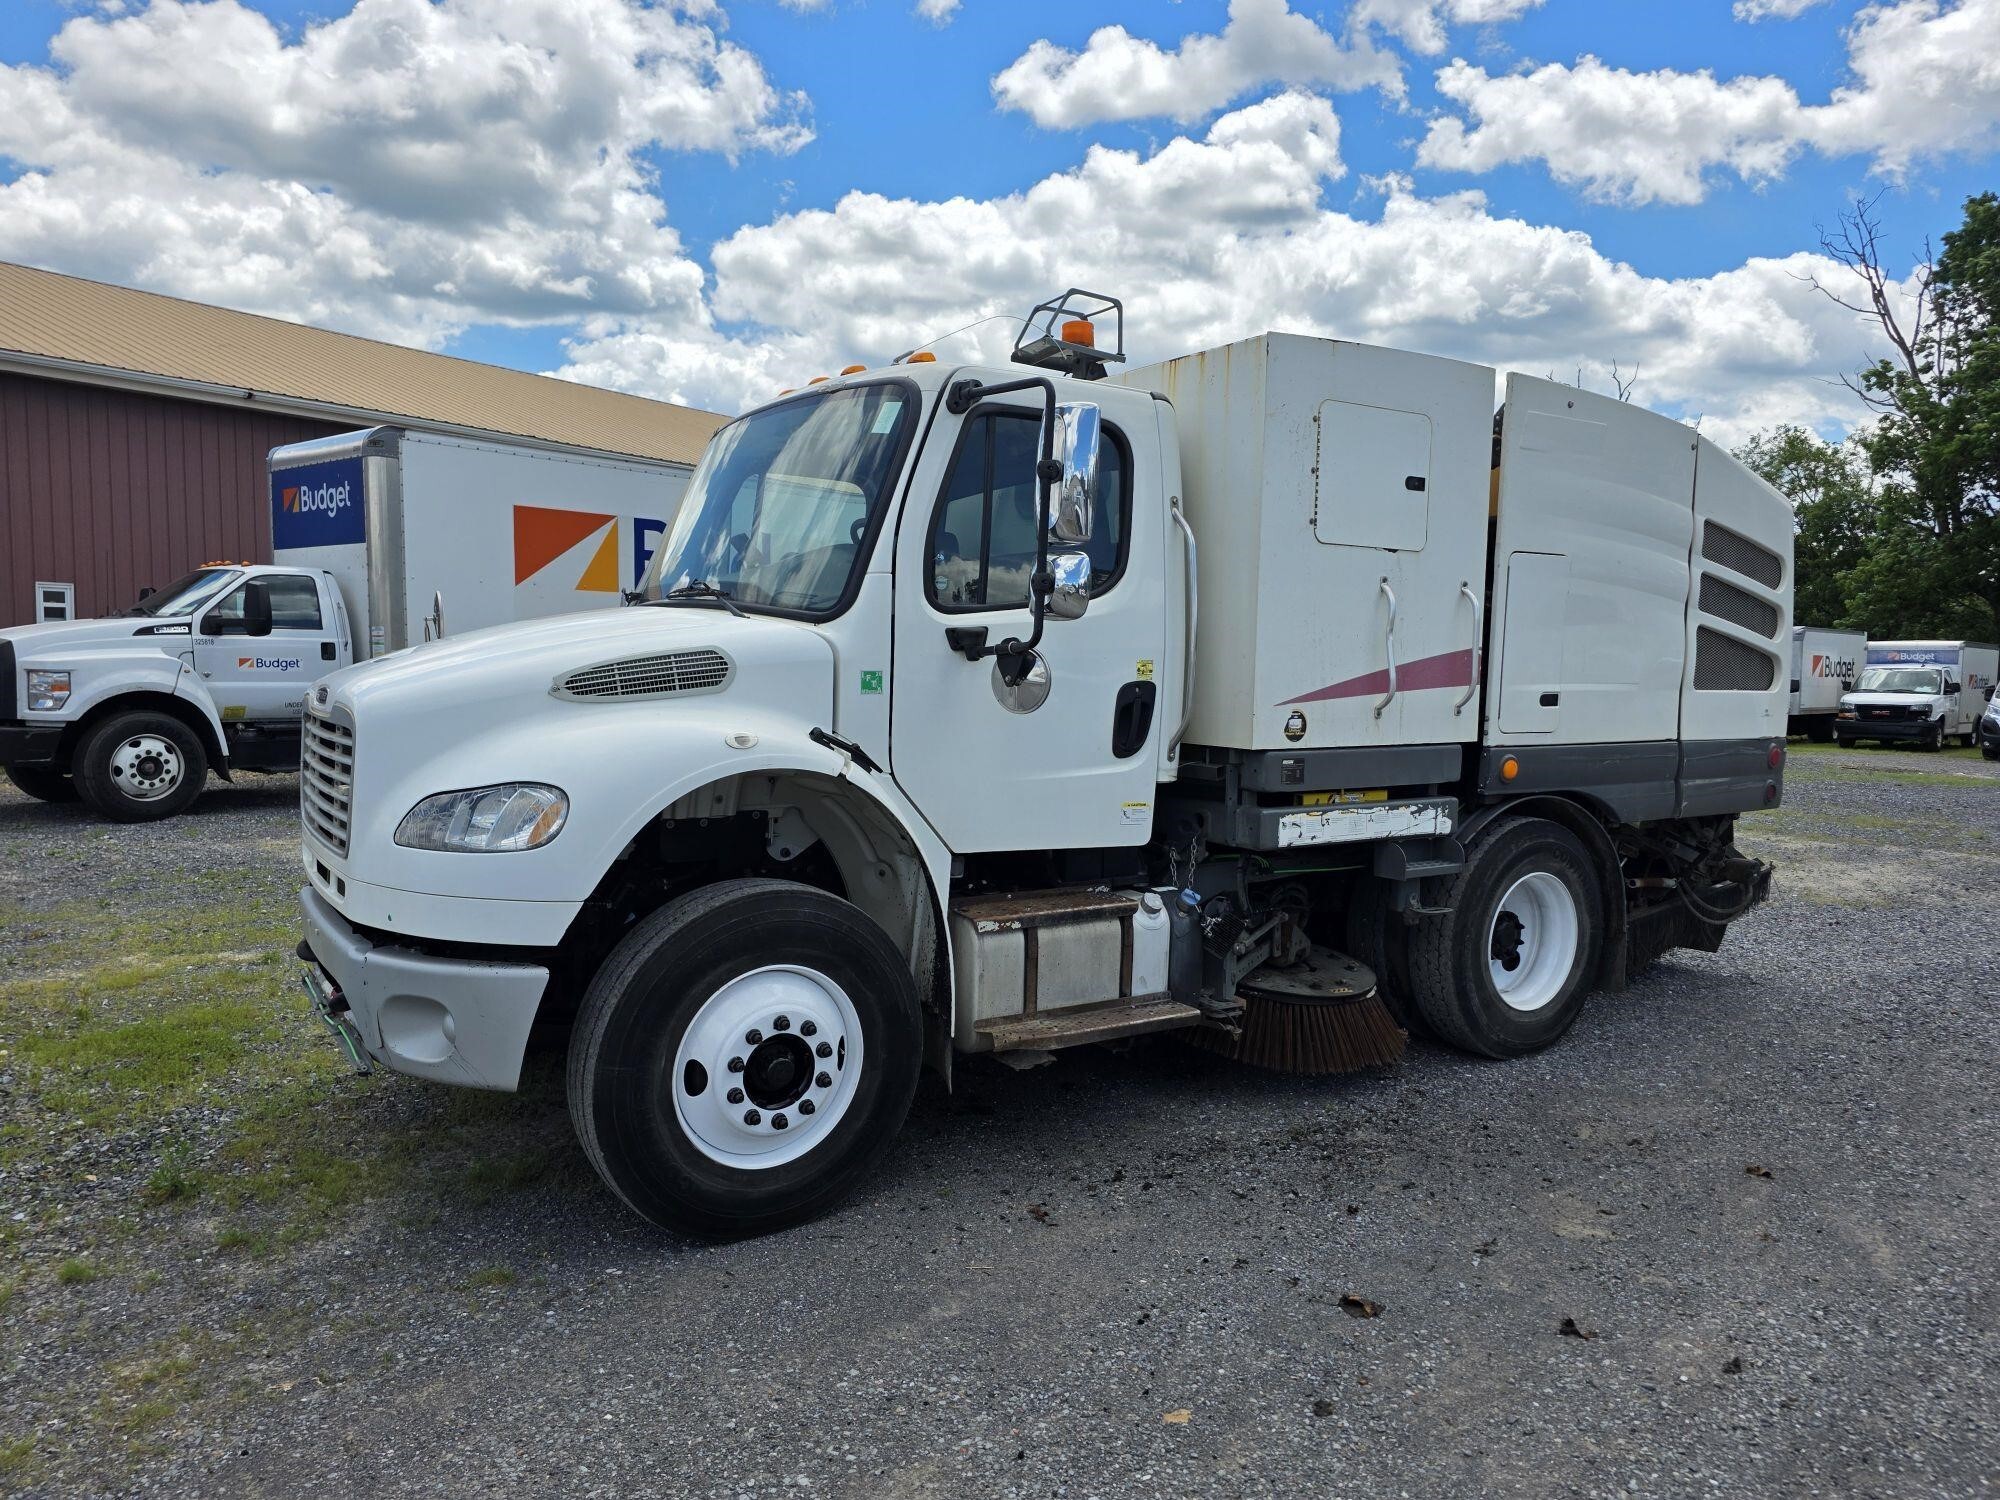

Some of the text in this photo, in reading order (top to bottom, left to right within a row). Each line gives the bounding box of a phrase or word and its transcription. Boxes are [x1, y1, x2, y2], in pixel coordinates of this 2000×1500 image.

[300, 480, 351, 518] Budget
[256, 657, 301, 671] Budget
[1900, 652, 1935, 662] Budget
[1824, 655, 1854, 681] Budget
